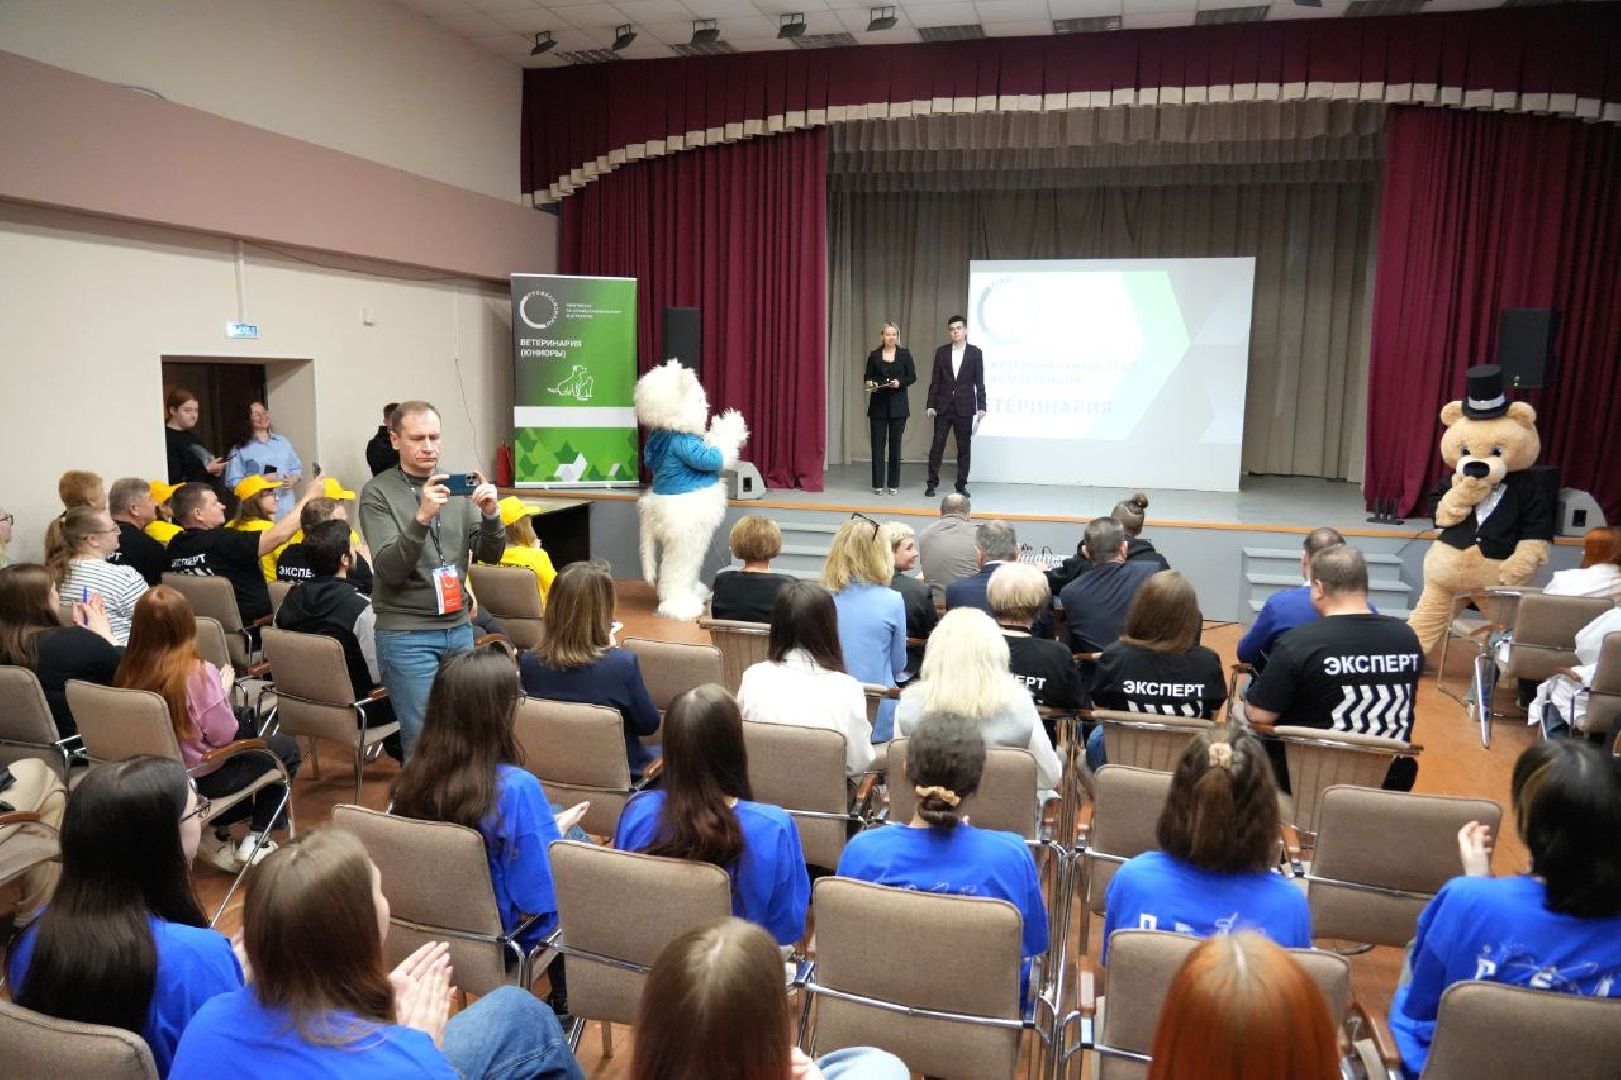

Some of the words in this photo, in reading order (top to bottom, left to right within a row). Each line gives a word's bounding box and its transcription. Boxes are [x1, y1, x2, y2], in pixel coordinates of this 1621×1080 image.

[520, 338, 582, 347] ВЕТЕРИНАРИЯ
[986, 397, 1113, 416] ТЕРИНАРИЯ
[278, 565, 316, 578] ЭКСПЕ
[1321, 653, 1418, 675] ЭКСПЕРТ
[1122, 680, 1205, 697] ЭКСПЕРТ
